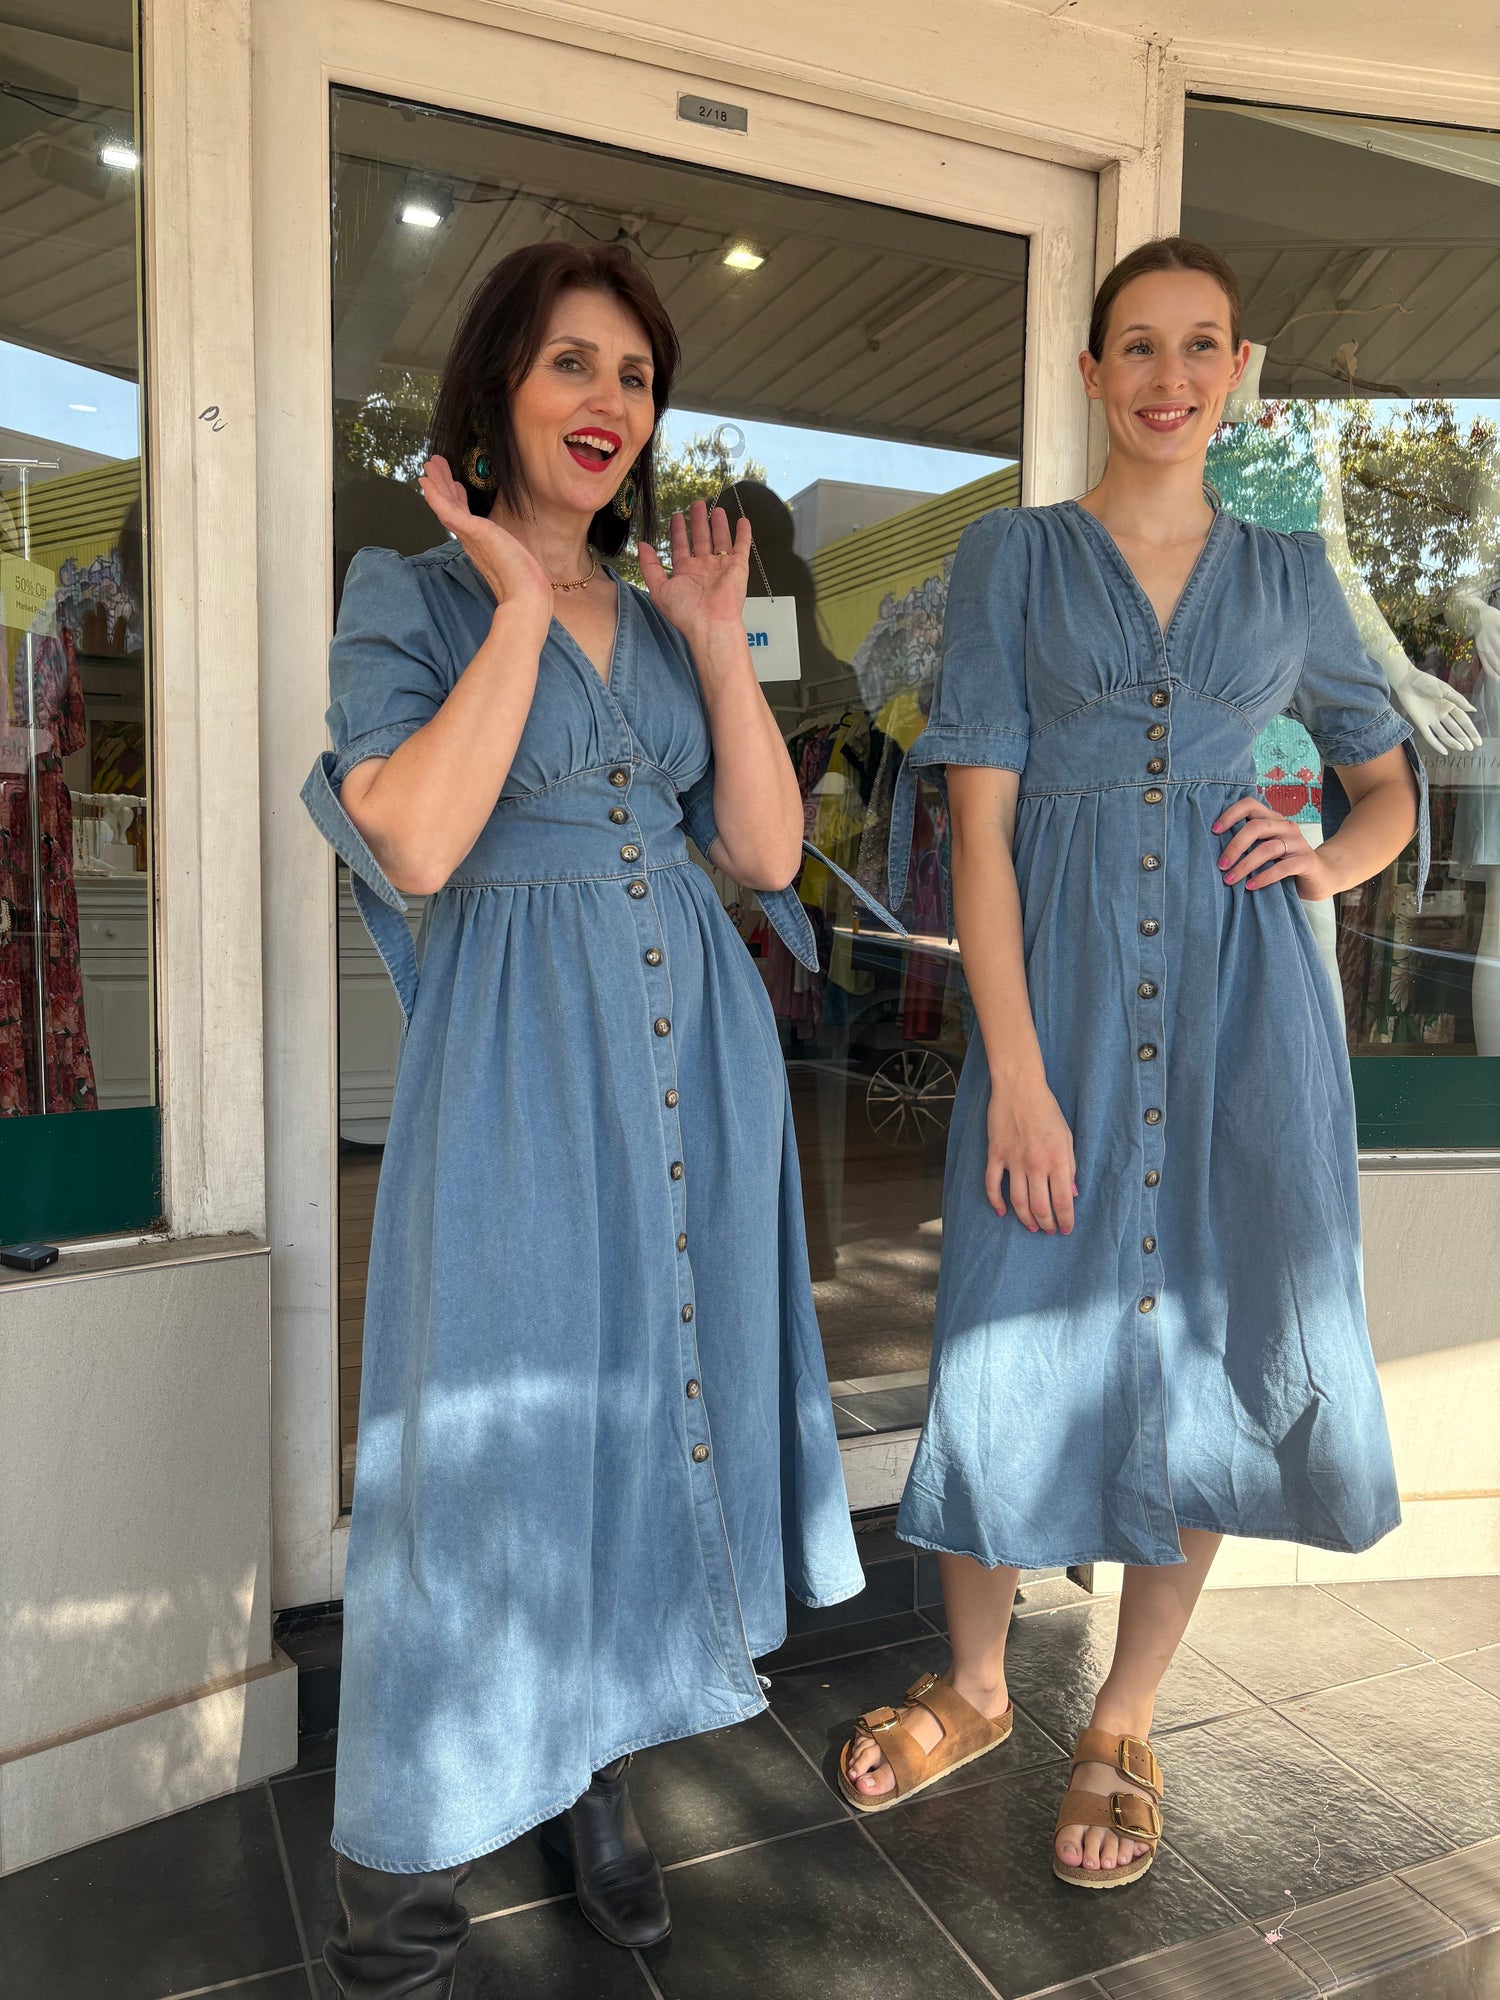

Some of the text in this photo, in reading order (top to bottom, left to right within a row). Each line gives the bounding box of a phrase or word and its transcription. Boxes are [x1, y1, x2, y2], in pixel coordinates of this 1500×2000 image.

[698, 105, 728, 122] 2/18
[15, 575, 47, 599] 50% Off
[746, 631, 769, 647] en
